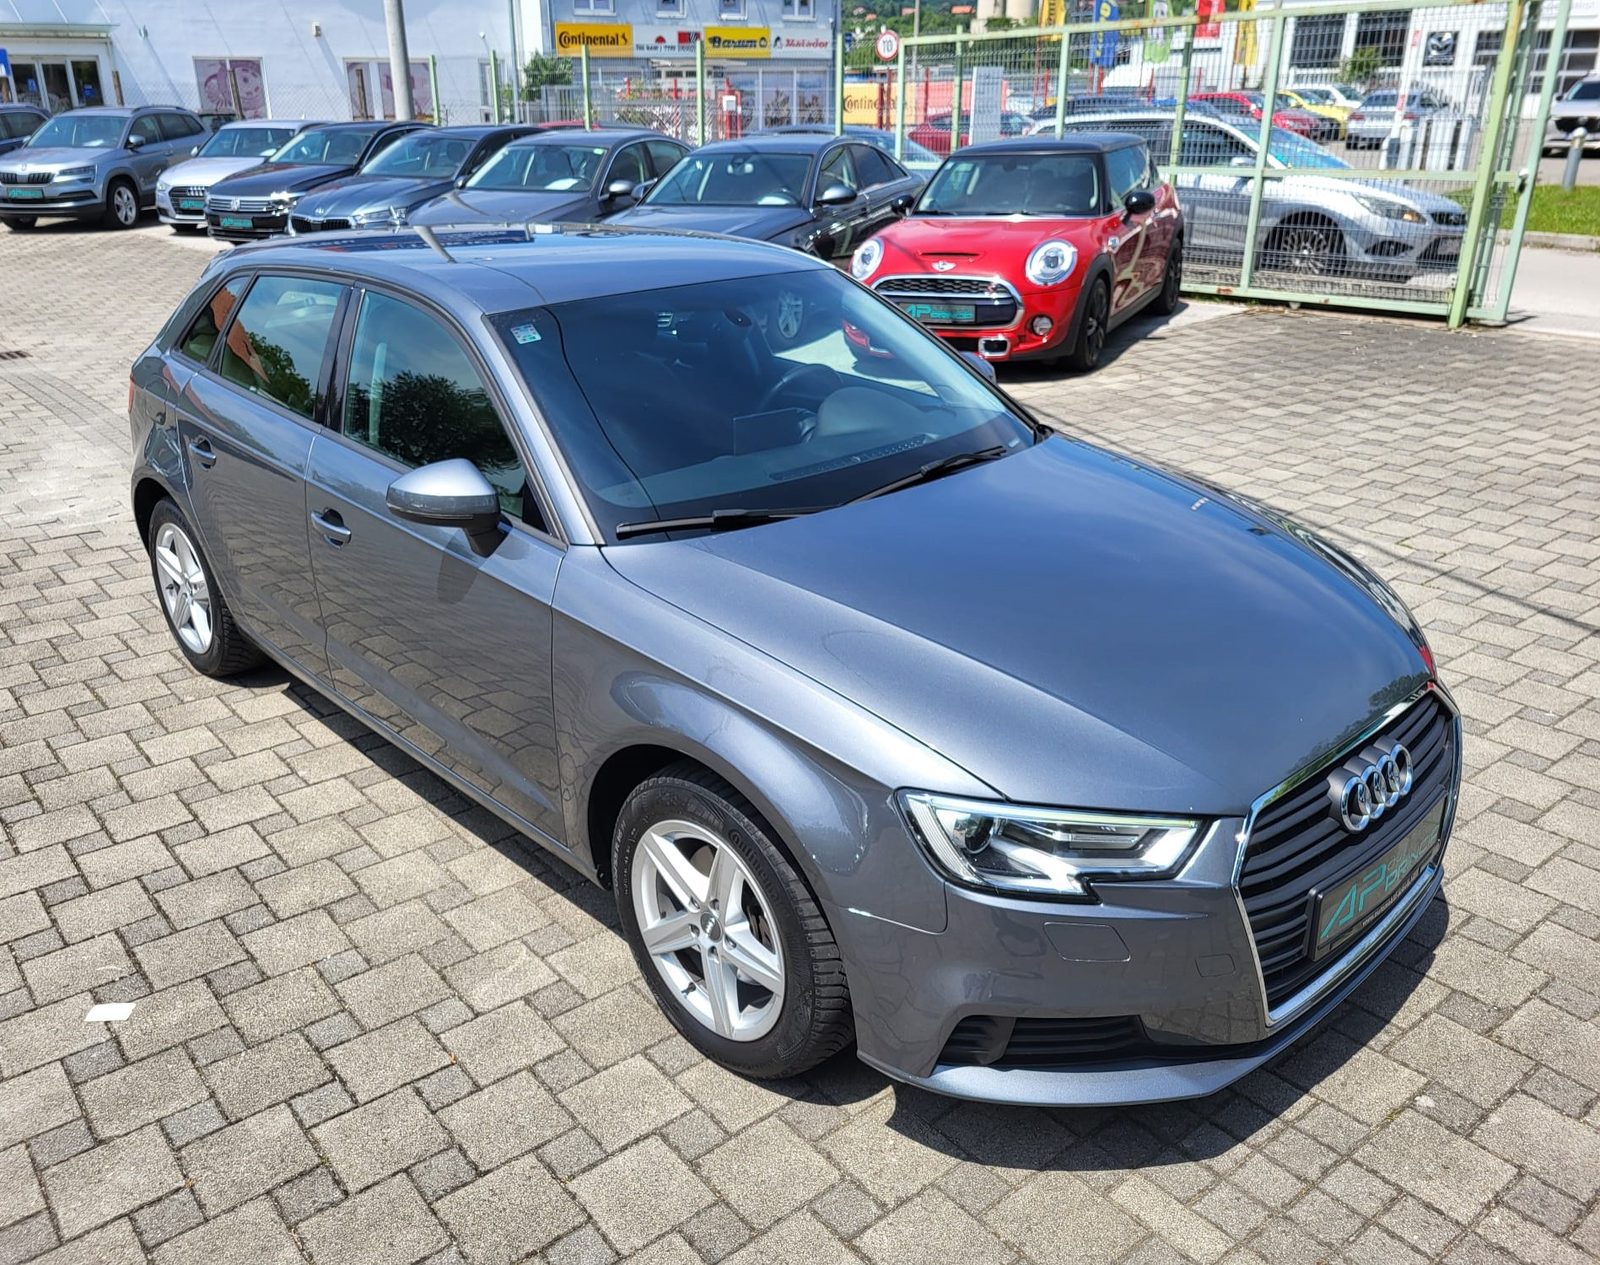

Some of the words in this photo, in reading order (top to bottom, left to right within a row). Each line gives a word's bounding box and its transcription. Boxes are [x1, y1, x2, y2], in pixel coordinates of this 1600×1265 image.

[558, 30, 619, 49] Continental
[882, 39, 894, 53] 10
[1321, 863, 1387, 938] AP
